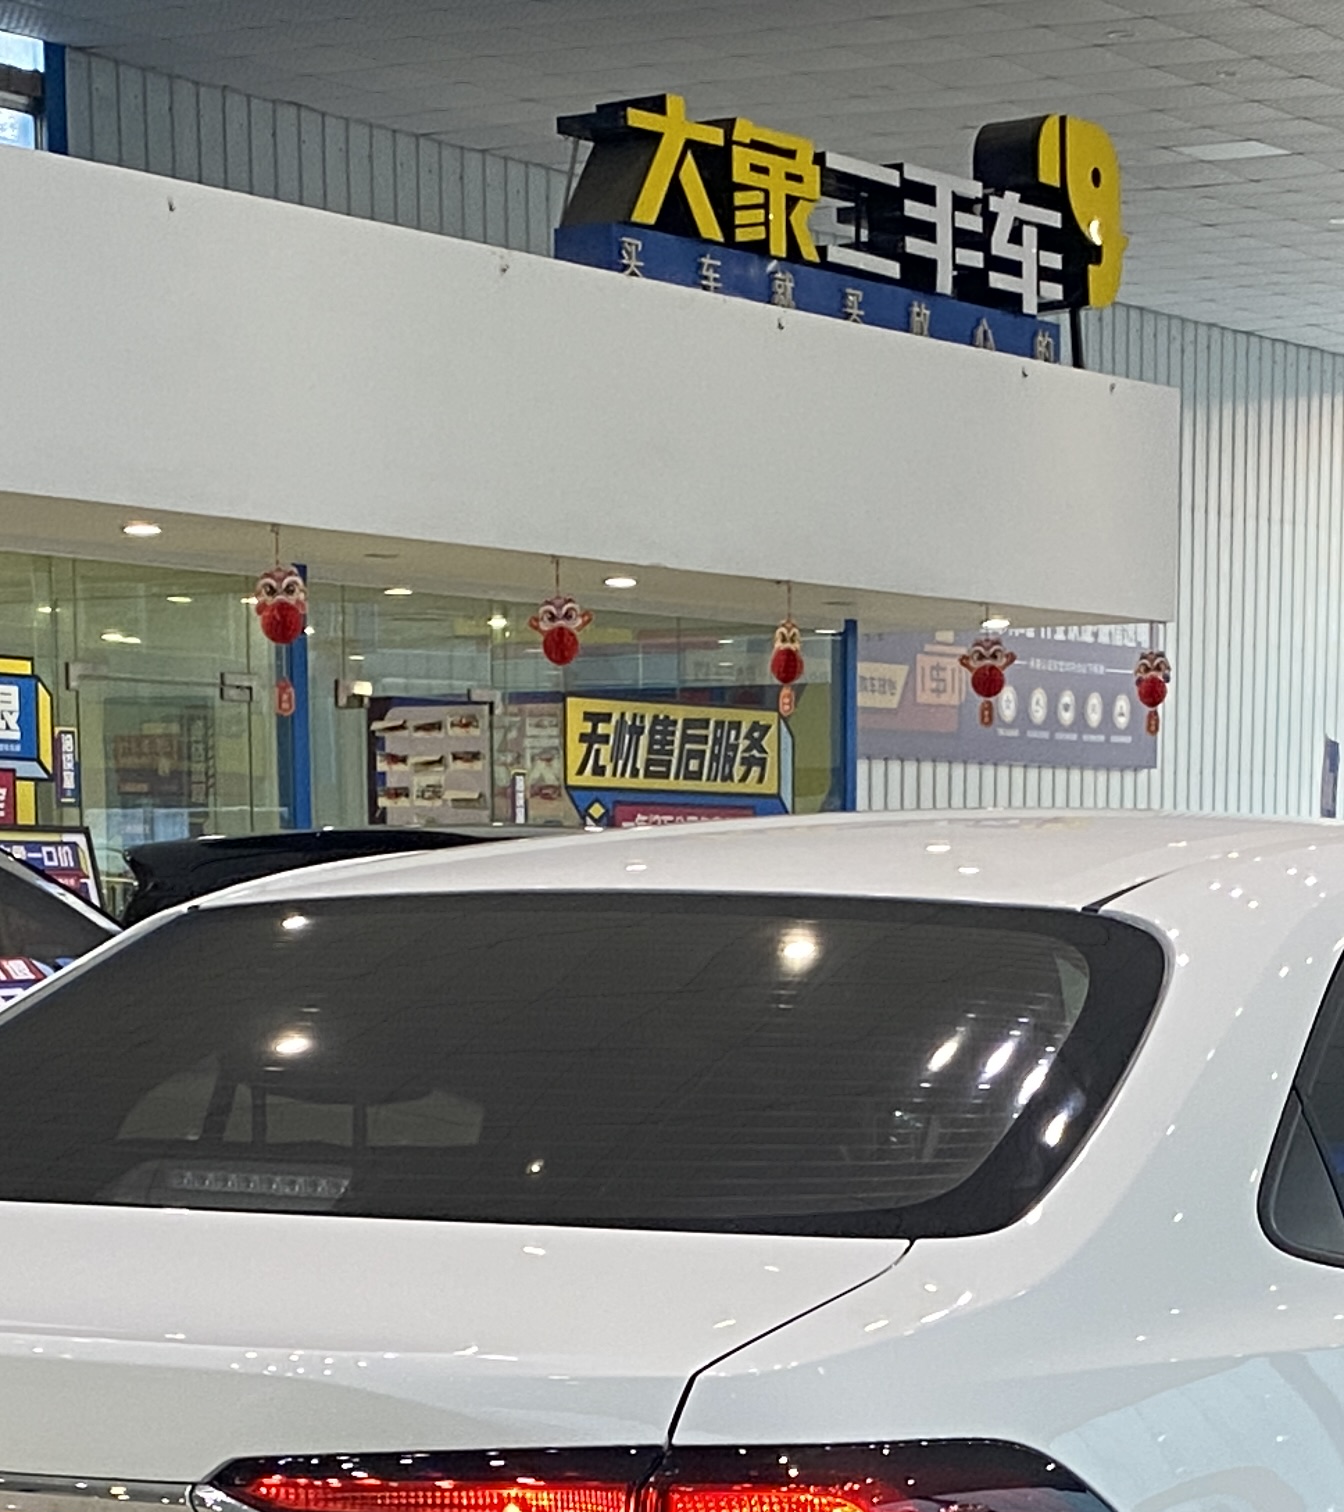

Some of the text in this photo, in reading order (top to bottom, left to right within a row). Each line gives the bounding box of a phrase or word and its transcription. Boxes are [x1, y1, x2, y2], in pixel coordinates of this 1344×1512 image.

[625, 93, 1063, 317] 大象二手车
[575, 710, 773, 785] 无忧售后服务
